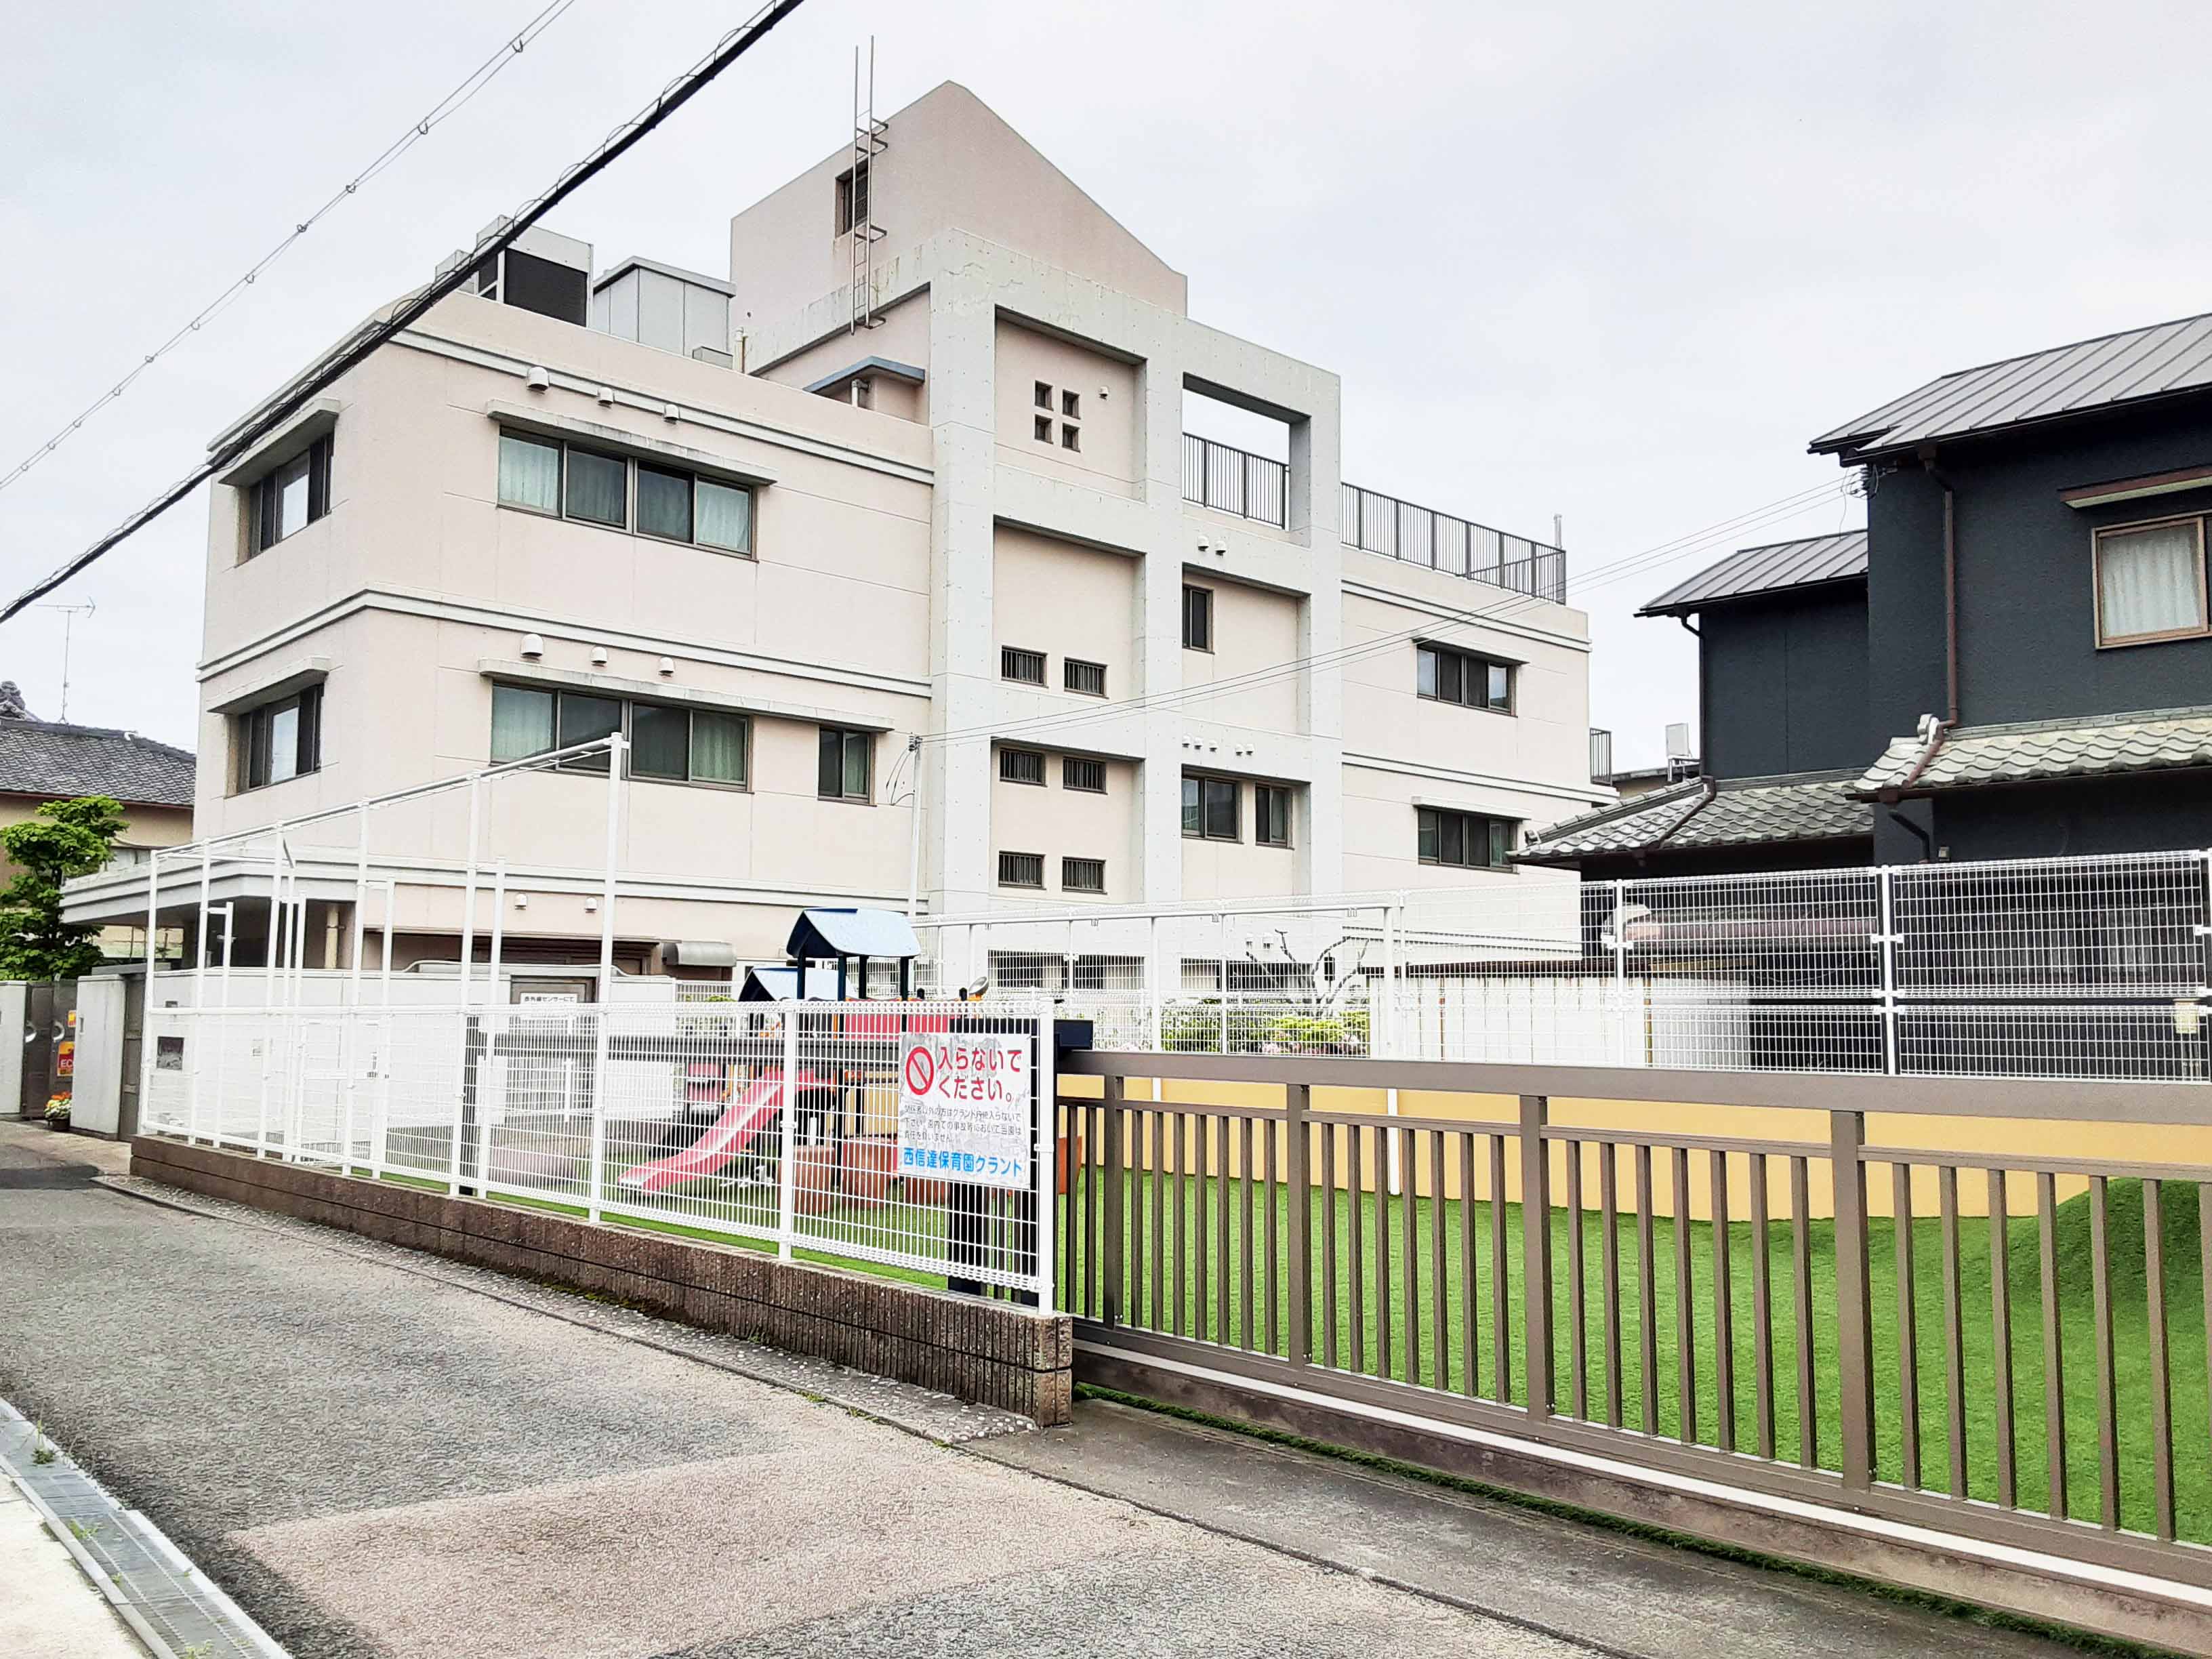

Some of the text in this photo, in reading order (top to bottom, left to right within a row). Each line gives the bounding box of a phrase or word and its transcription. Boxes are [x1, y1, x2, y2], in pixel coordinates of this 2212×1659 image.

[937, 1046, 1023, 1073] 入らないで
[938, 1075, 1012, 1103] ください。
